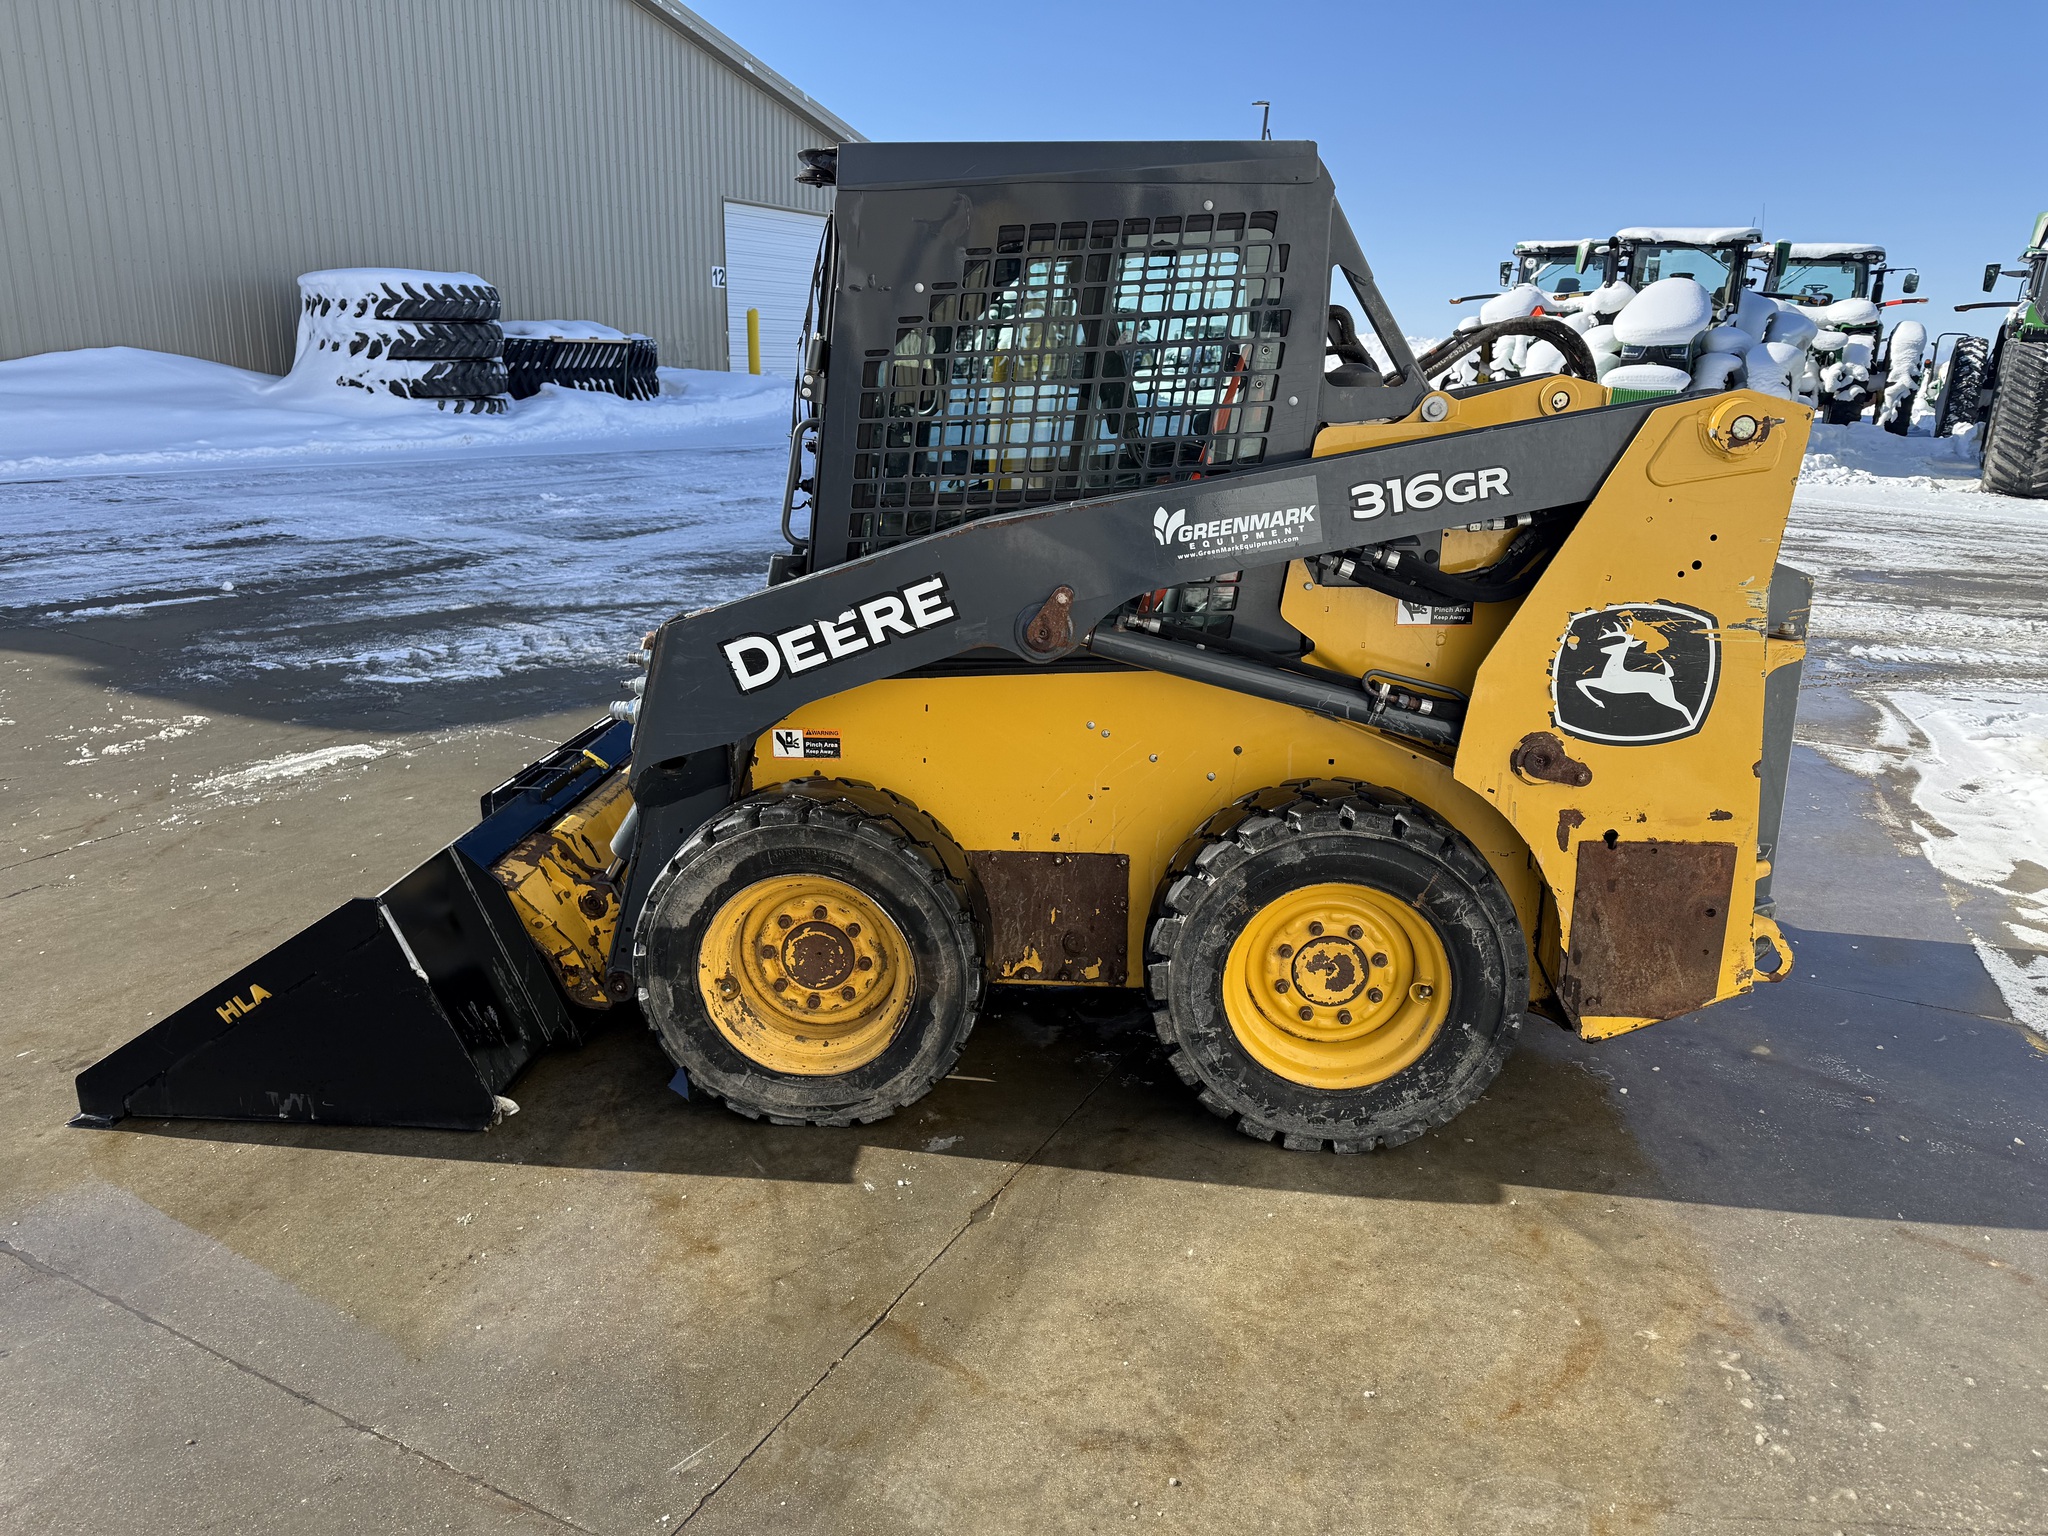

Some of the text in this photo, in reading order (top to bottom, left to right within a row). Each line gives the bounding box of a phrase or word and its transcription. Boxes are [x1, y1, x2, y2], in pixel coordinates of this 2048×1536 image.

[713, 268, 725, 286] 12
[1350, 467, 1511, 520] 316GR
[1177, 504, 1317, 543] GREENMARK
[1189, 524, 1306, 550] EQUIPMENT
[1177, 536, 1300, 560] www.GreenMarkEquipment.com
[723, 577, 955, 692] DEERE
[215, 983, 273, 1024] HLA
